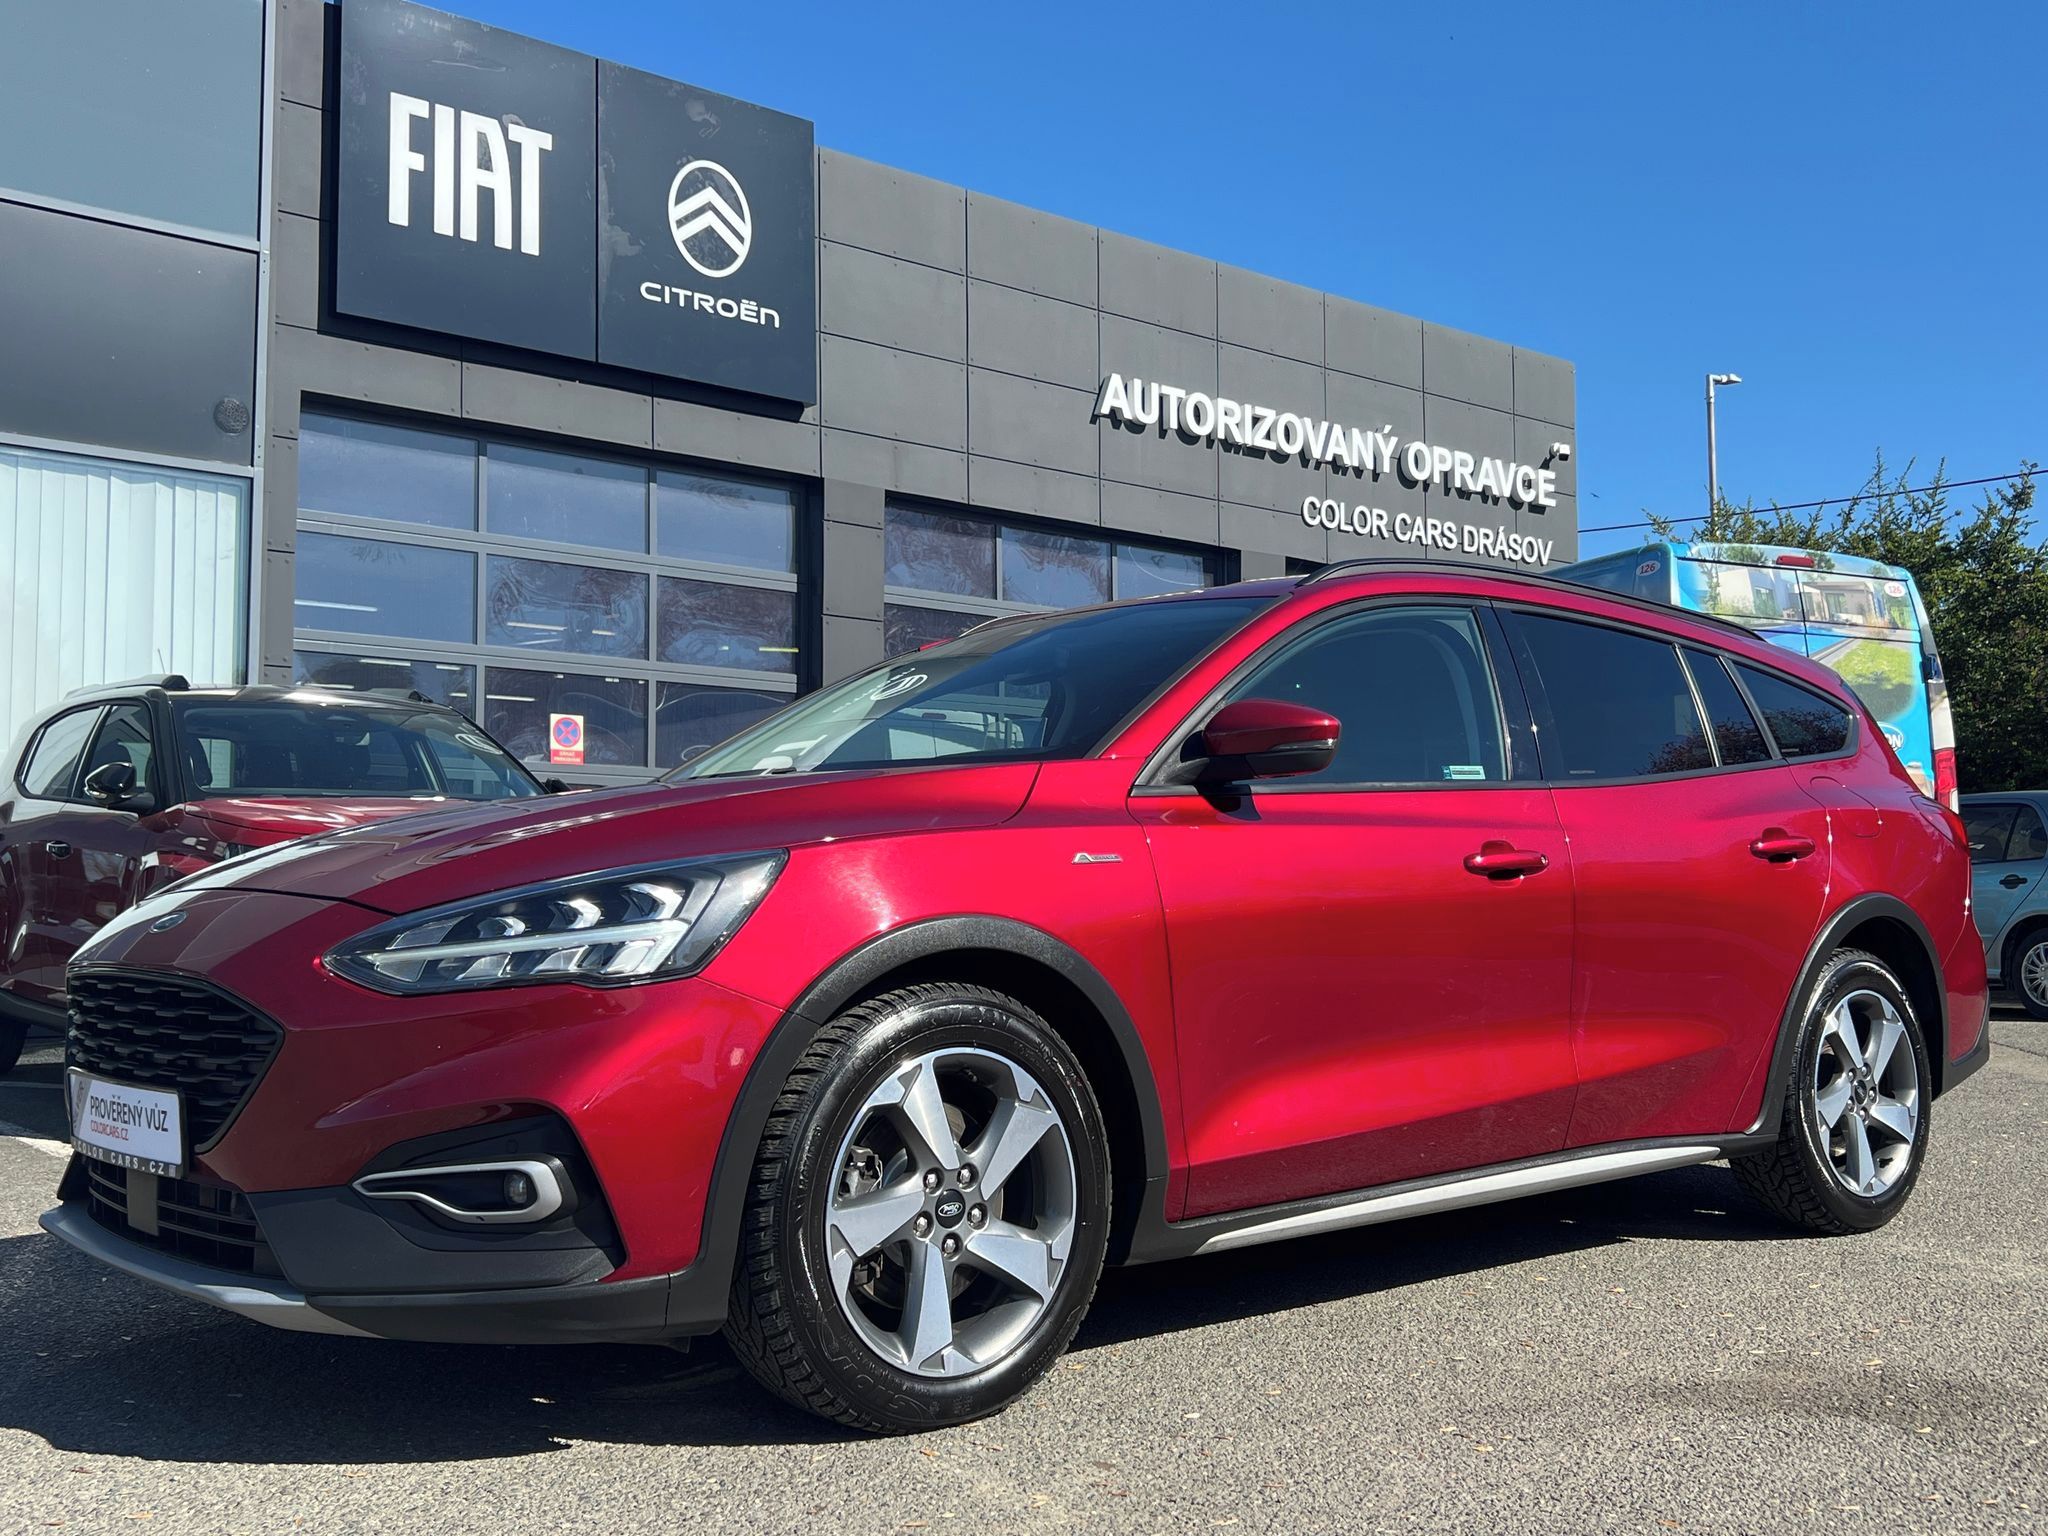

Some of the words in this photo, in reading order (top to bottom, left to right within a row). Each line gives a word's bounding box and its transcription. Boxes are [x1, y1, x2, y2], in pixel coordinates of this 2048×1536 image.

[388, 91, 553, 257] FIAT
[1099, 372, 1398, 475] AUTORIZOVANÝ
[1402, 440, 1557, 508] OPRAVCE
[1302, 495, 1388, 540] COLOR
[1395, 510, 1458, 551] CARS
[1462, 525, 1553, 567] DRÁSOV
[1639, 562, 1656, 575] 126
[90, 1093, 143, 1128] PROVĚŘENÝ
[144, 1102, 169, 1133] VŮZ
